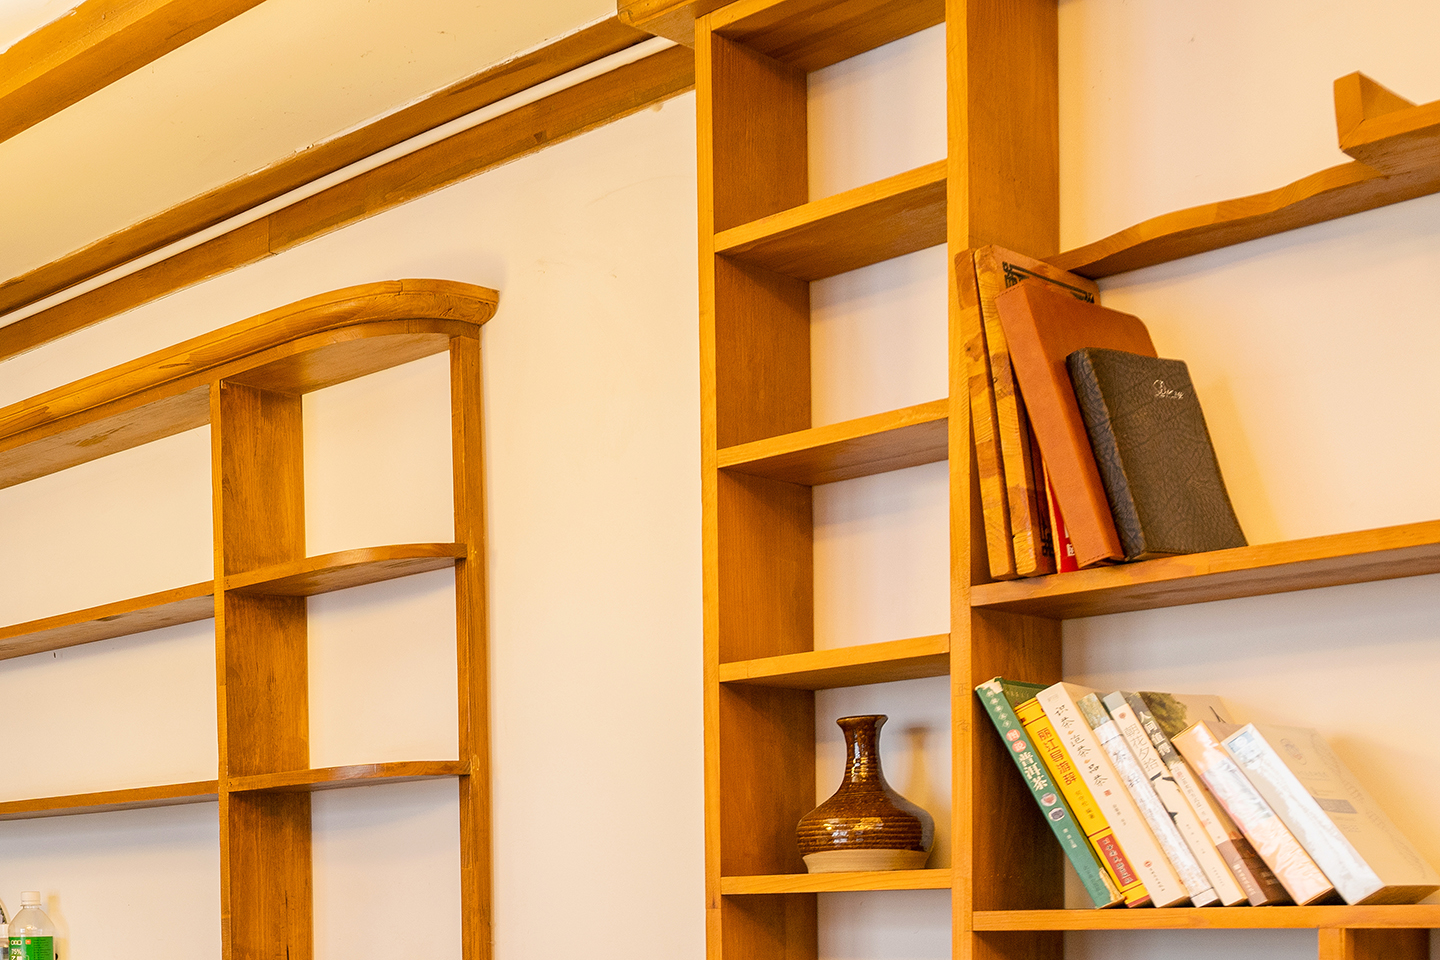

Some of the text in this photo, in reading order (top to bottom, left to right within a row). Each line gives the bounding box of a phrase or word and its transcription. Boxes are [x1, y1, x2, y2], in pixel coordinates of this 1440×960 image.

[1125, 722, 1160, 772] 朝花夕拾
[1139, 710, 1172, 757] 人间值得
